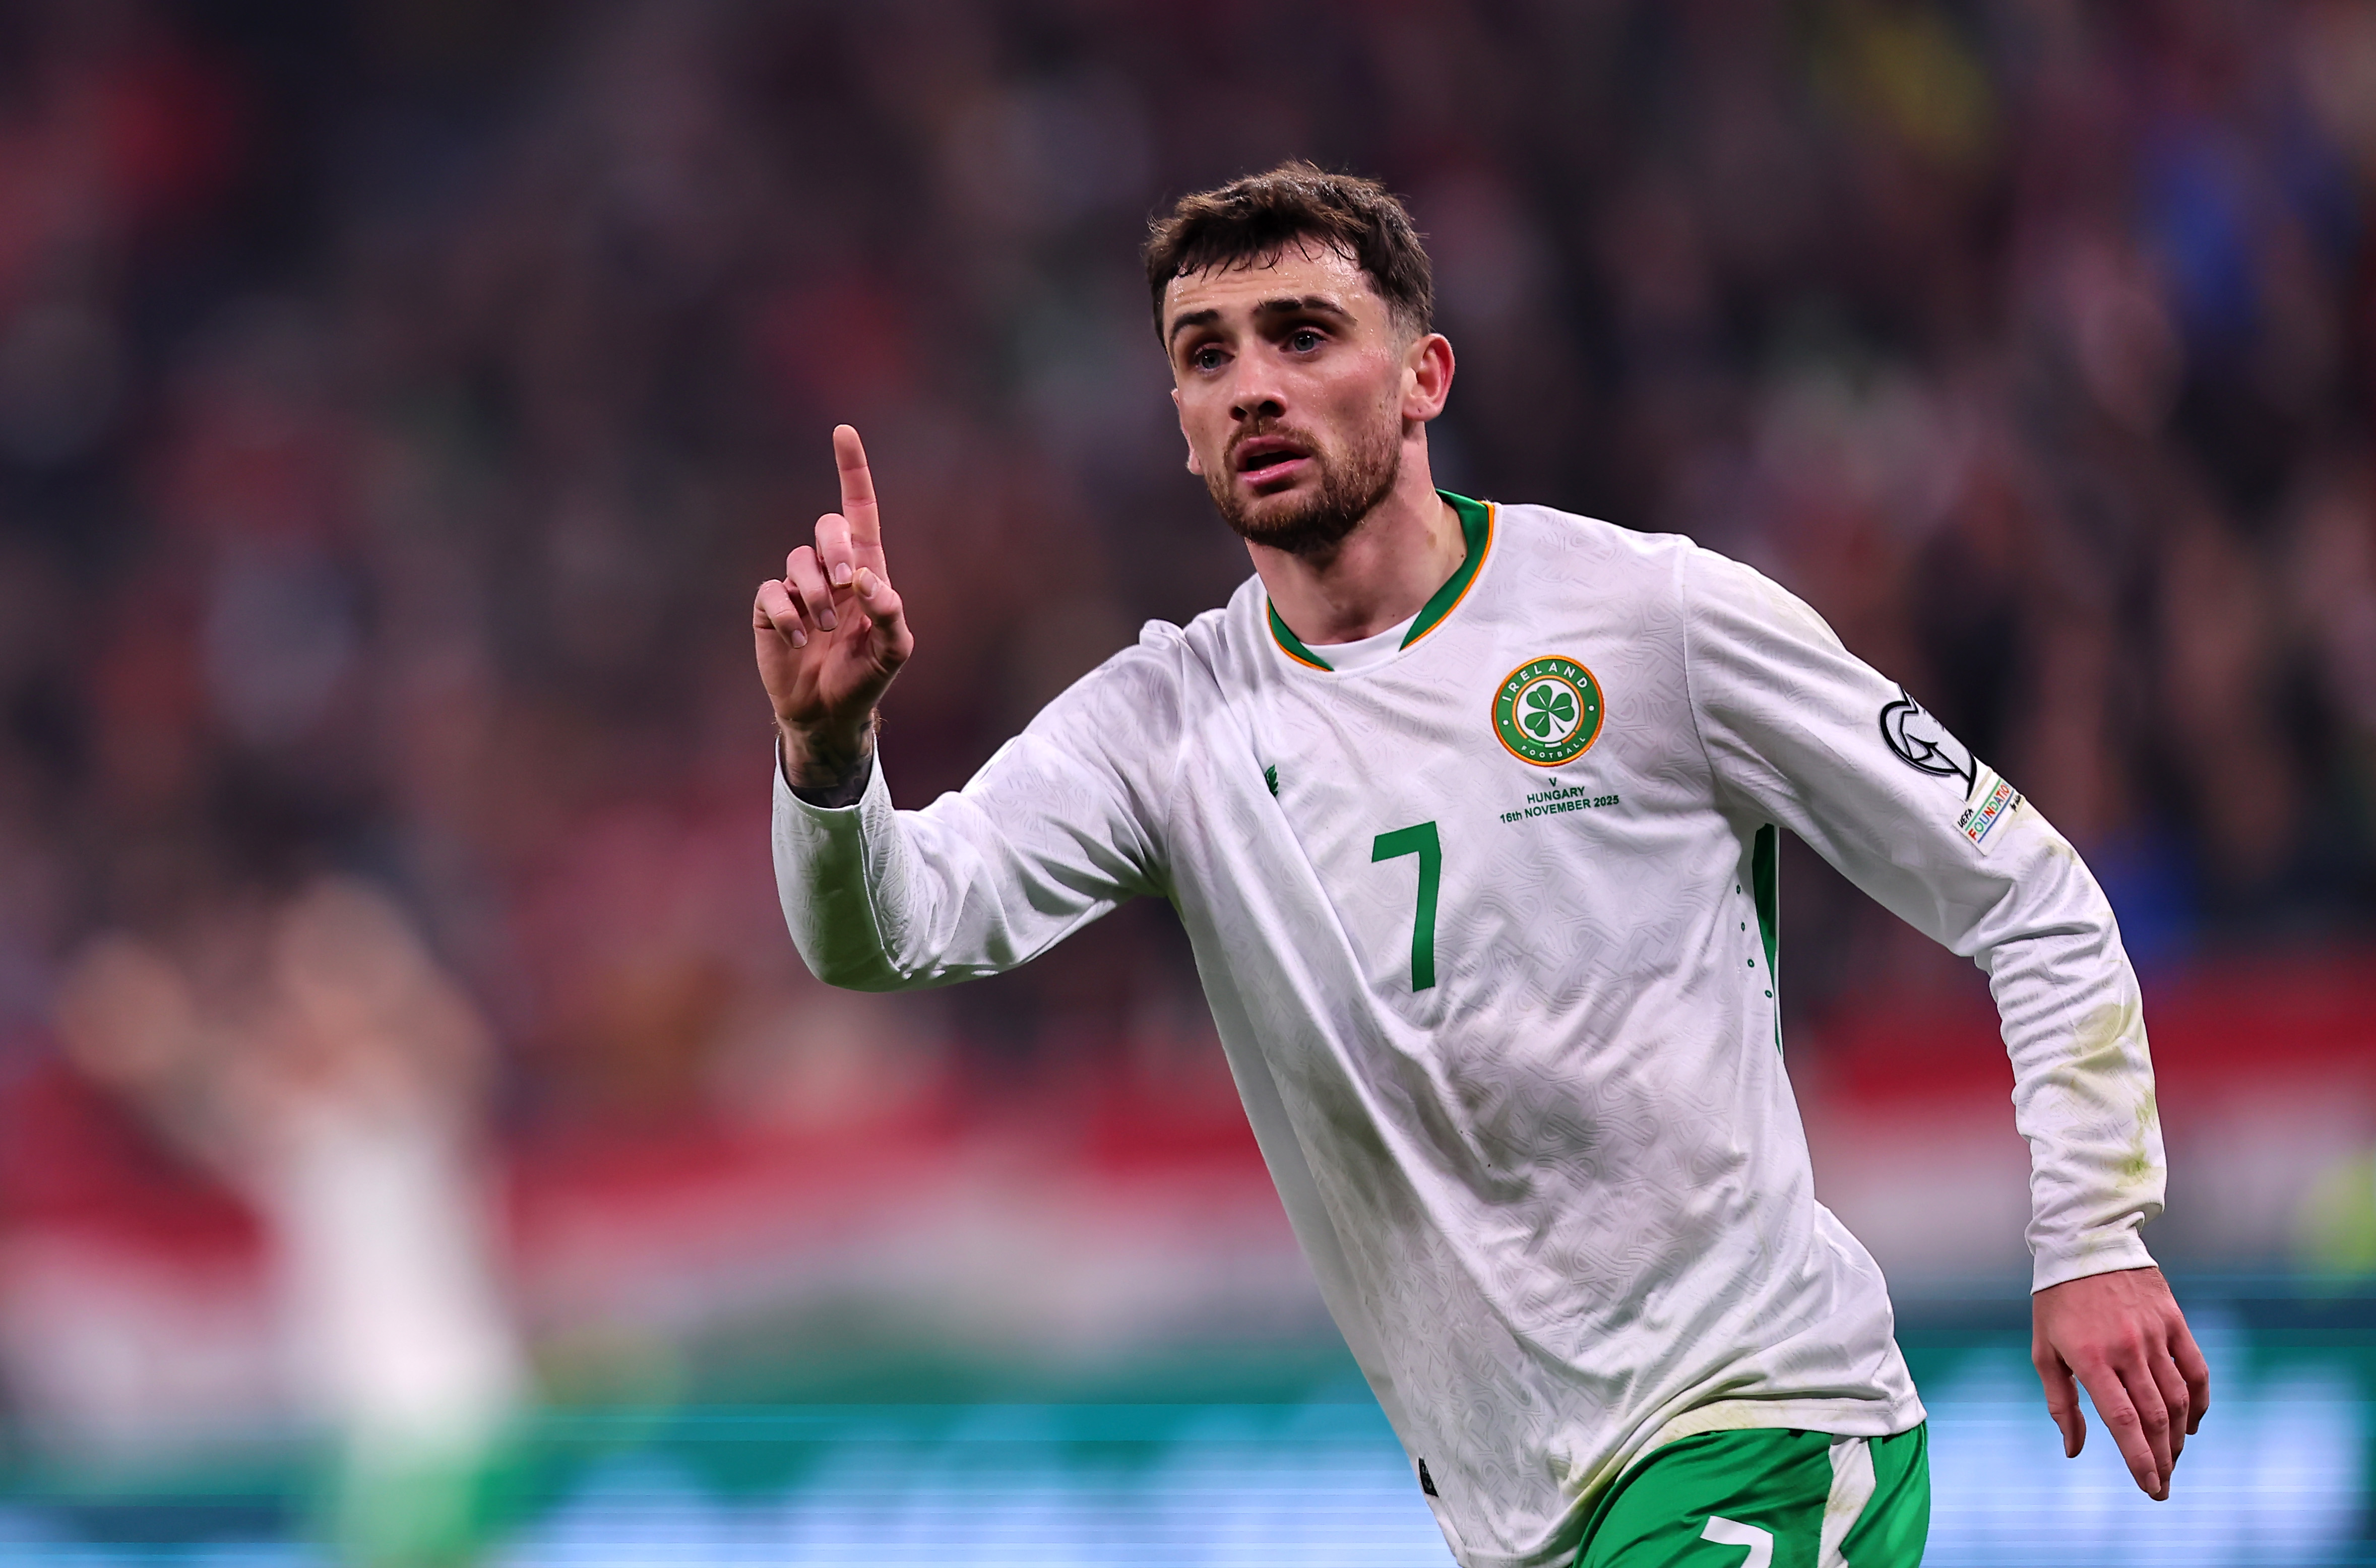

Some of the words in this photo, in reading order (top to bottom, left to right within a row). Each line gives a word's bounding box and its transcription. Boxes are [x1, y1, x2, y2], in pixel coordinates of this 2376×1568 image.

[1502, 662, 1587, 702] IRELAND
[1521, 737, 1586, 759] FOOTBALL
[1500, 811, 1522, 824] 16th
[1525, 798, 1591, 818] NOVEMBER
[1593, 795, 1619, 807] 2025
[1527, 786, 1585, 804] HUNGARY
[1958, 808, 1974, 828] UEFA
[1968, 782, 2011, 841] FOUNDATIO
[1371, 821, 1442, 992] 7
